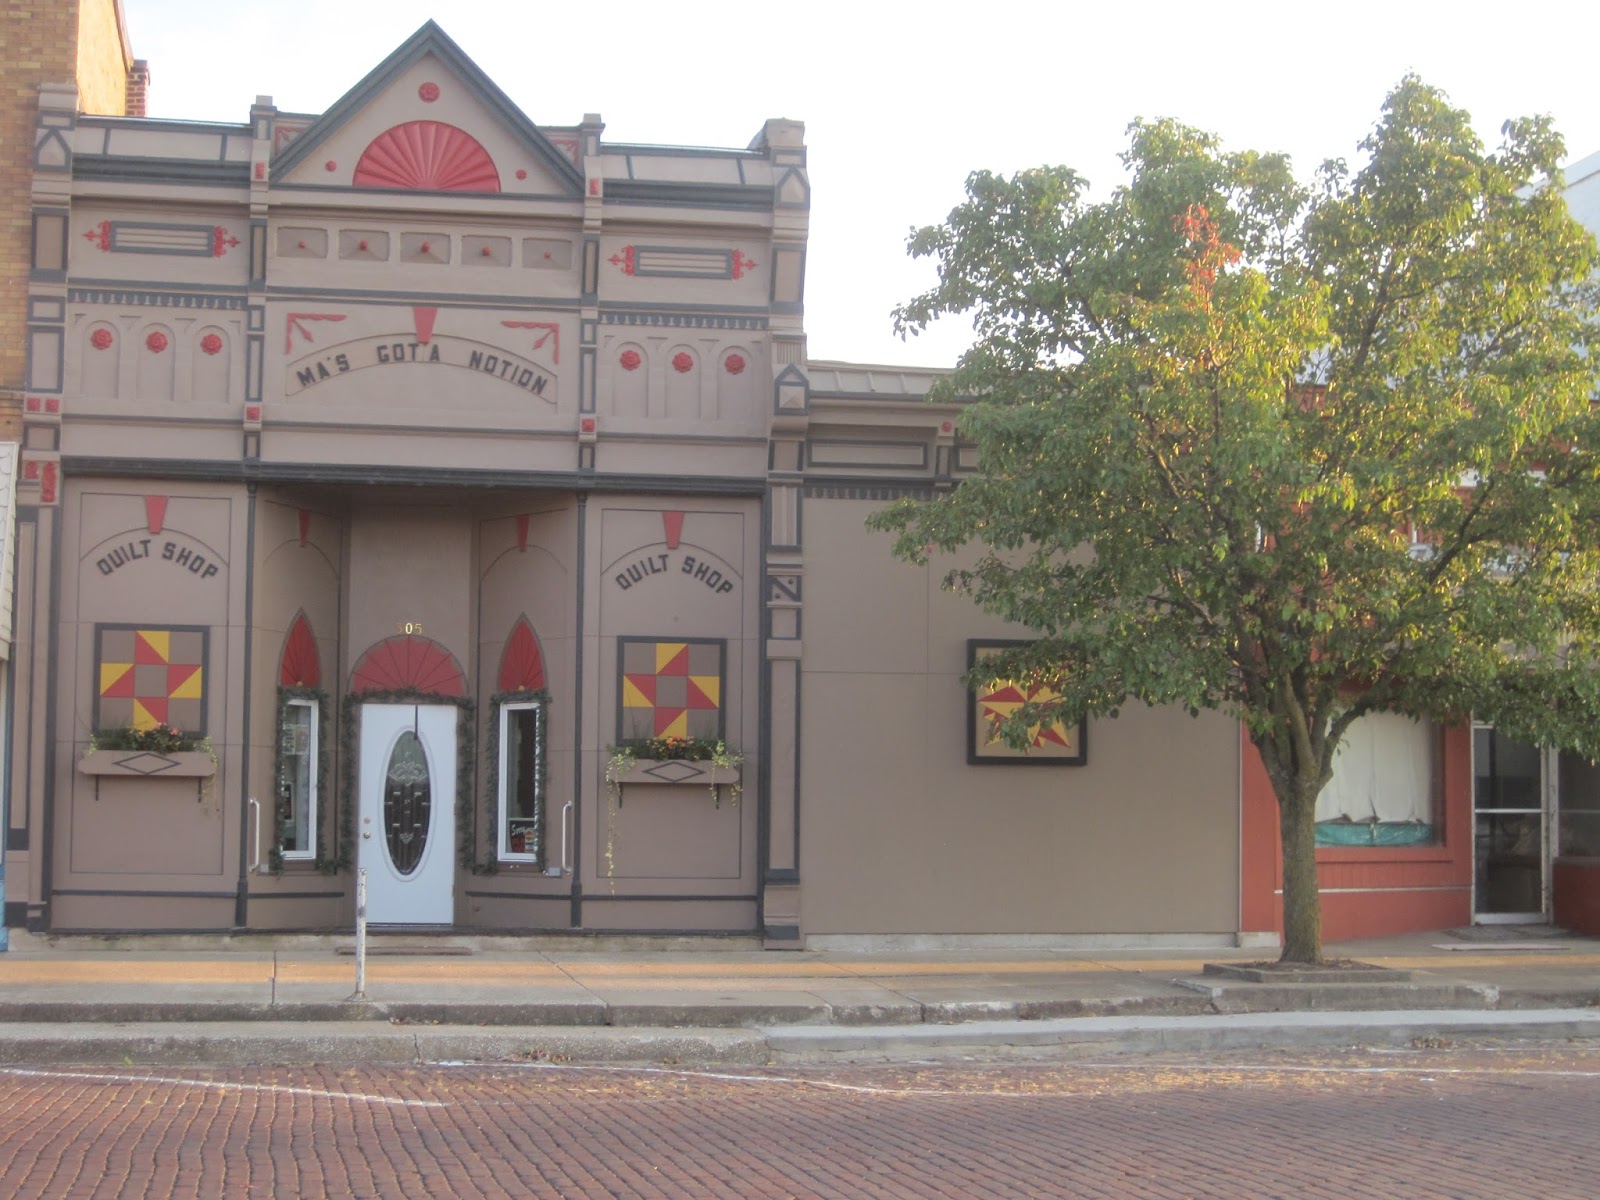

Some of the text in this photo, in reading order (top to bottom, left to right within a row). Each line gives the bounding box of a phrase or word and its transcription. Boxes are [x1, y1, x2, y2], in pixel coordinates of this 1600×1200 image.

[296, 343, 548, 394] MA'S GOT A NOTION
[96, 539, 218, 578] QUILT SHOP
[615, 554, 733, 593] QUILT SHOP
